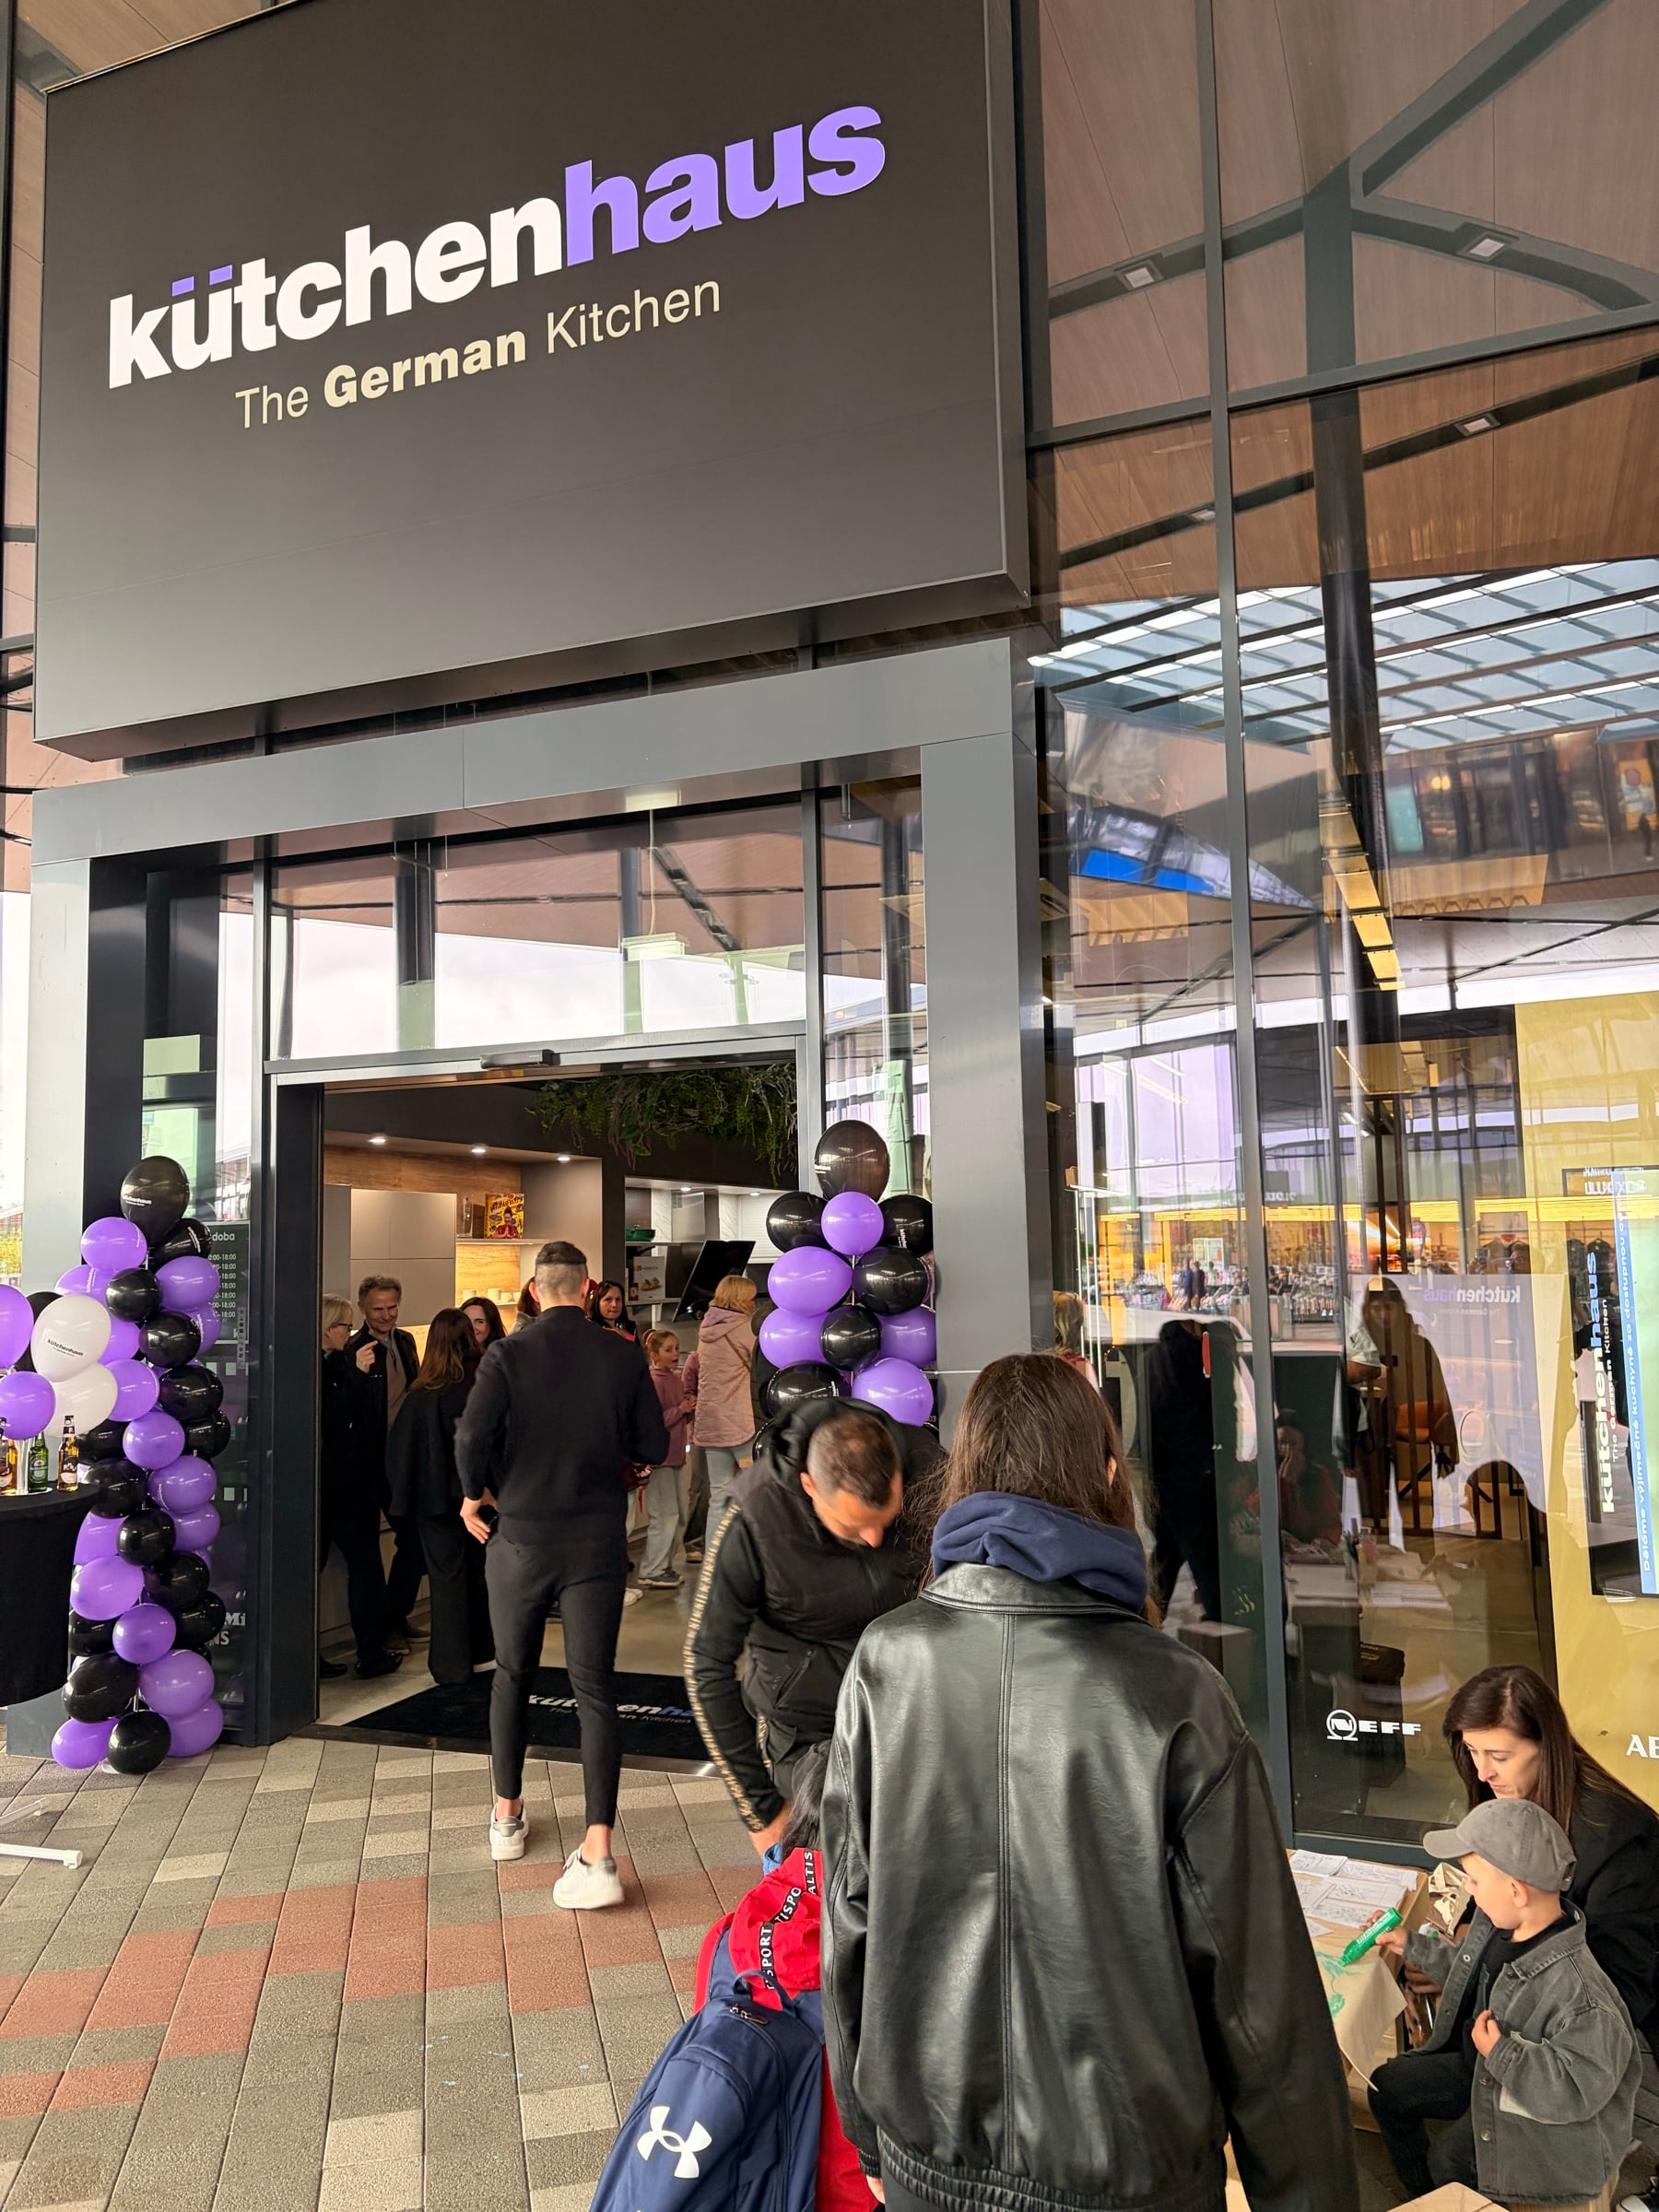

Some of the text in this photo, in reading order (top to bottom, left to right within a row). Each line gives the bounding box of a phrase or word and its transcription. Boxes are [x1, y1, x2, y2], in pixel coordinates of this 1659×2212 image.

[109, 105, 887, 389] kütchenhaus
[236, 279, 722, 429] The German Kitchen
[212, 1231, 235, 1241] doba
[1587, 1252, 1616, 1513] kütchenhaus
[1326, 1709, 1422, 1742] NEFF
